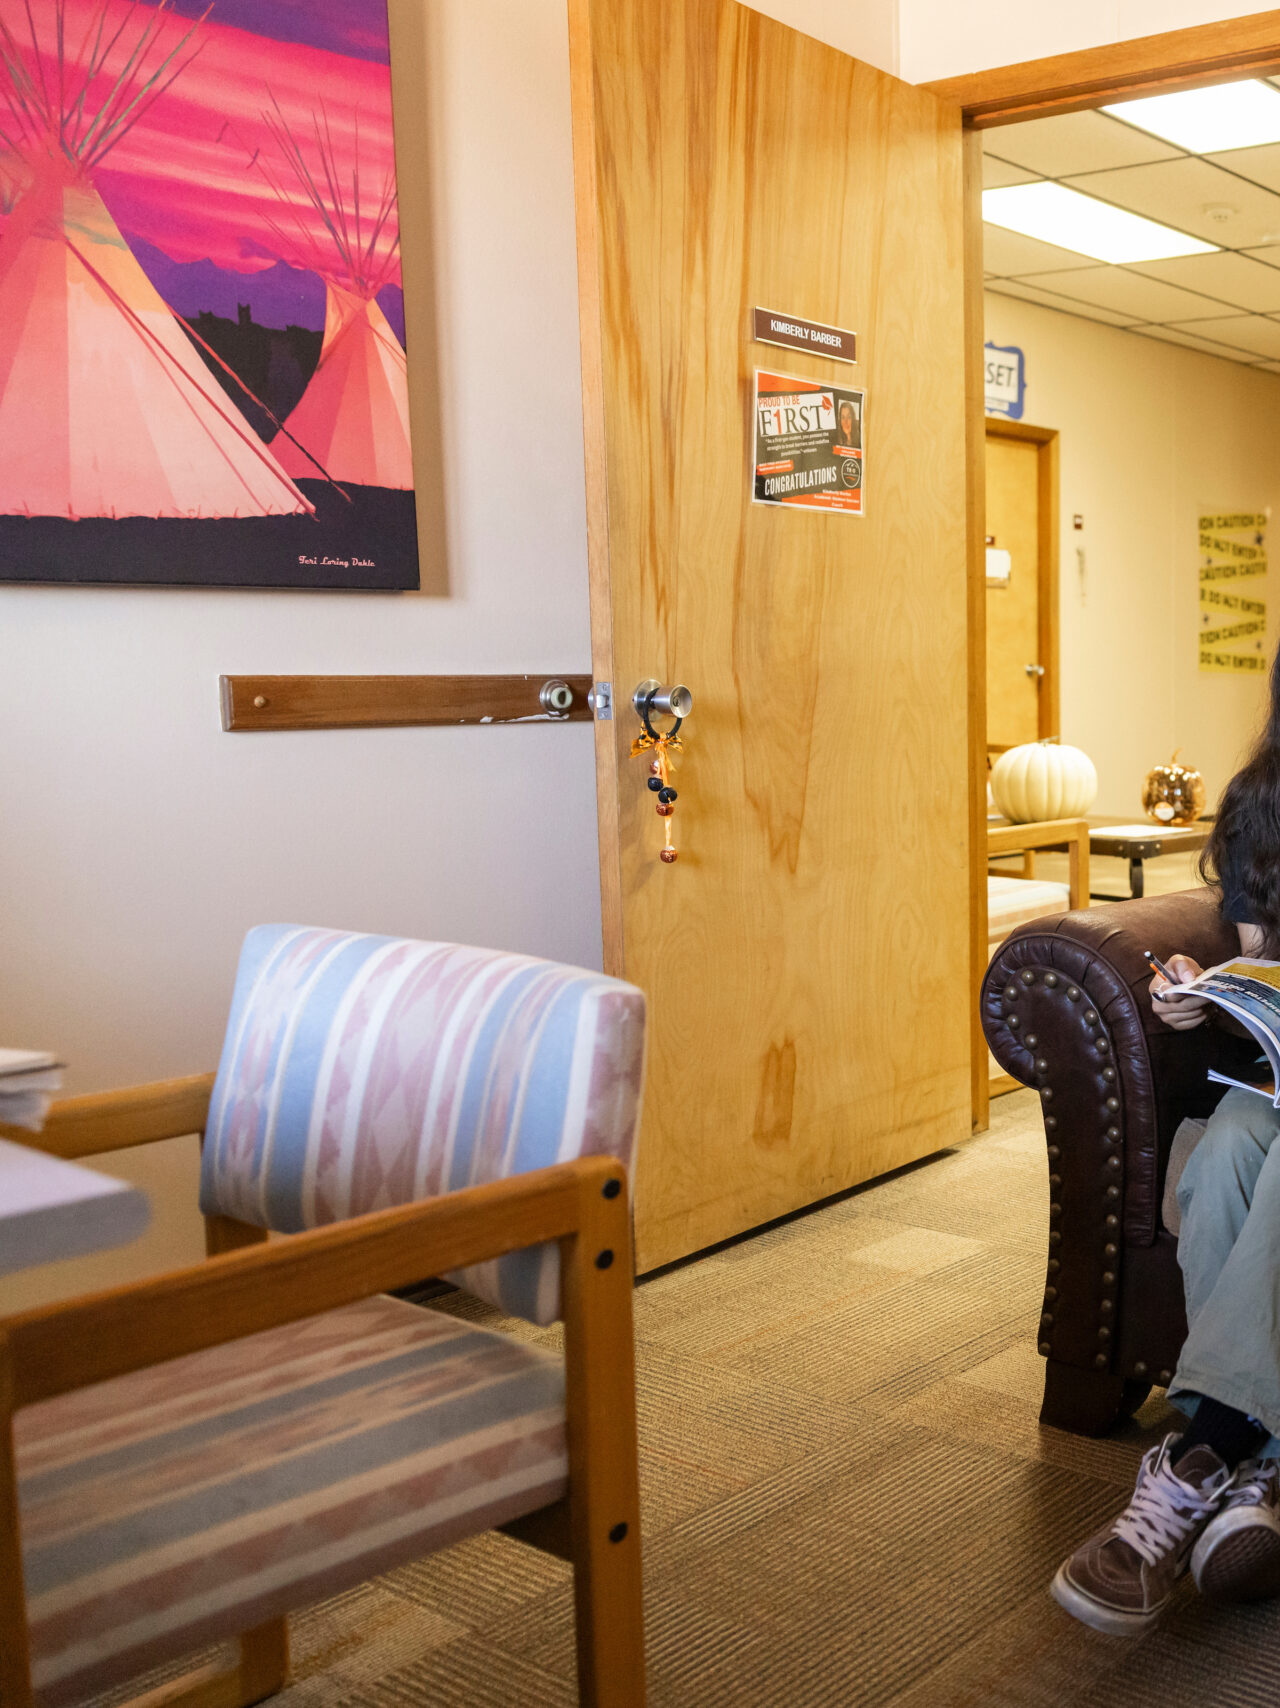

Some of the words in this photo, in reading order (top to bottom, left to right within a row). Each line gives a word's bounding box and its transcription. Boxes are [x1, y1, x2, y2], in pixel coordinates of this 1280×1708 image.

[771, 319, 809, 339] KIMBERLY
[810, 329, 842, 348] BARBER
[985, 361, 1015, 387] SET
[758, 396, 782, 408] PROUD
[782, 395, 791, 406] TO
[791, 394, 801, 405] BE
[764, 466, 837, 496] CONGRATULATIONS
[1216, 514, 1255, 529] CAUTION
[320, 556, 349, 568] Loring
[352, 557, 375, 567] Dahle
[1199, 565, 1236, 582] CAUTION
[1222, 621, 1258, 640] CAUTION
